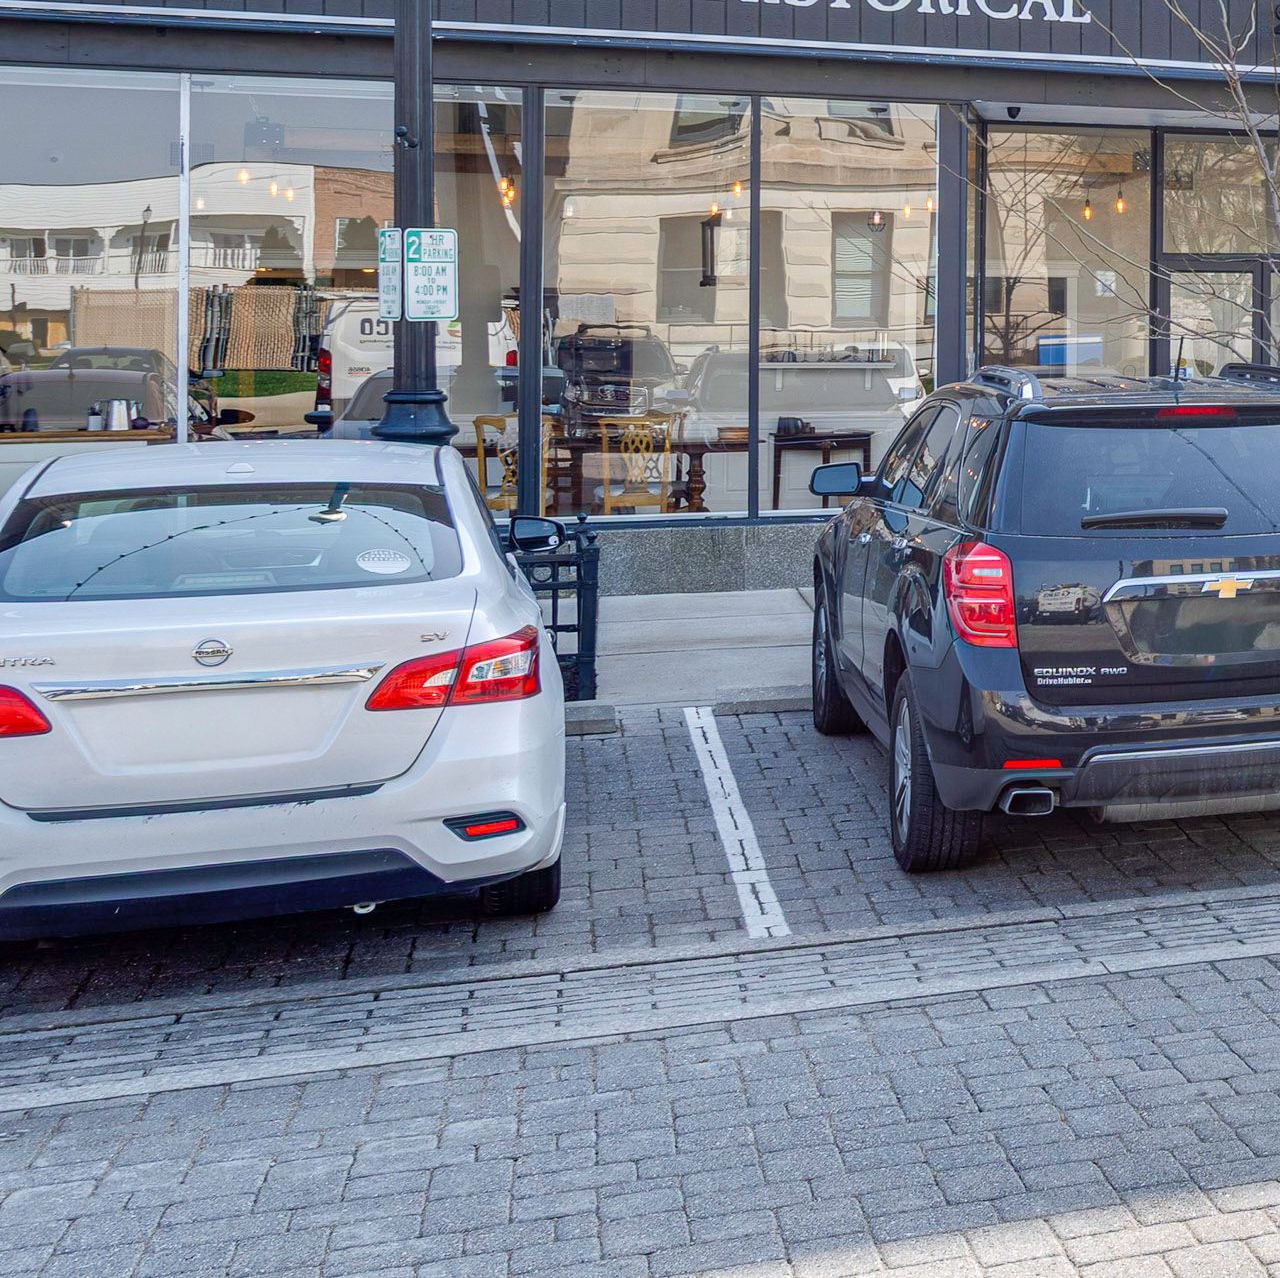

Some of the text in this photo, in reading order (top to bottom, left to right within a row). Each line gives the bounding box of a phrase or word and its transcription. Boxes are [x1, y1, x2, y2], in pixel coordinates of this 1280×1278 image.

[408, 235, 420, 258] 2
[431, 234, 444, 245] HR
[423, 248, 453, 259] PARKING
[414, 265, 447, 277] 8:00 AM
[415, 285, 448, 296] 4:00 PM
[420, 632, 449, 643] SV
[1034, 667, 1096, 676] EQUINOX
